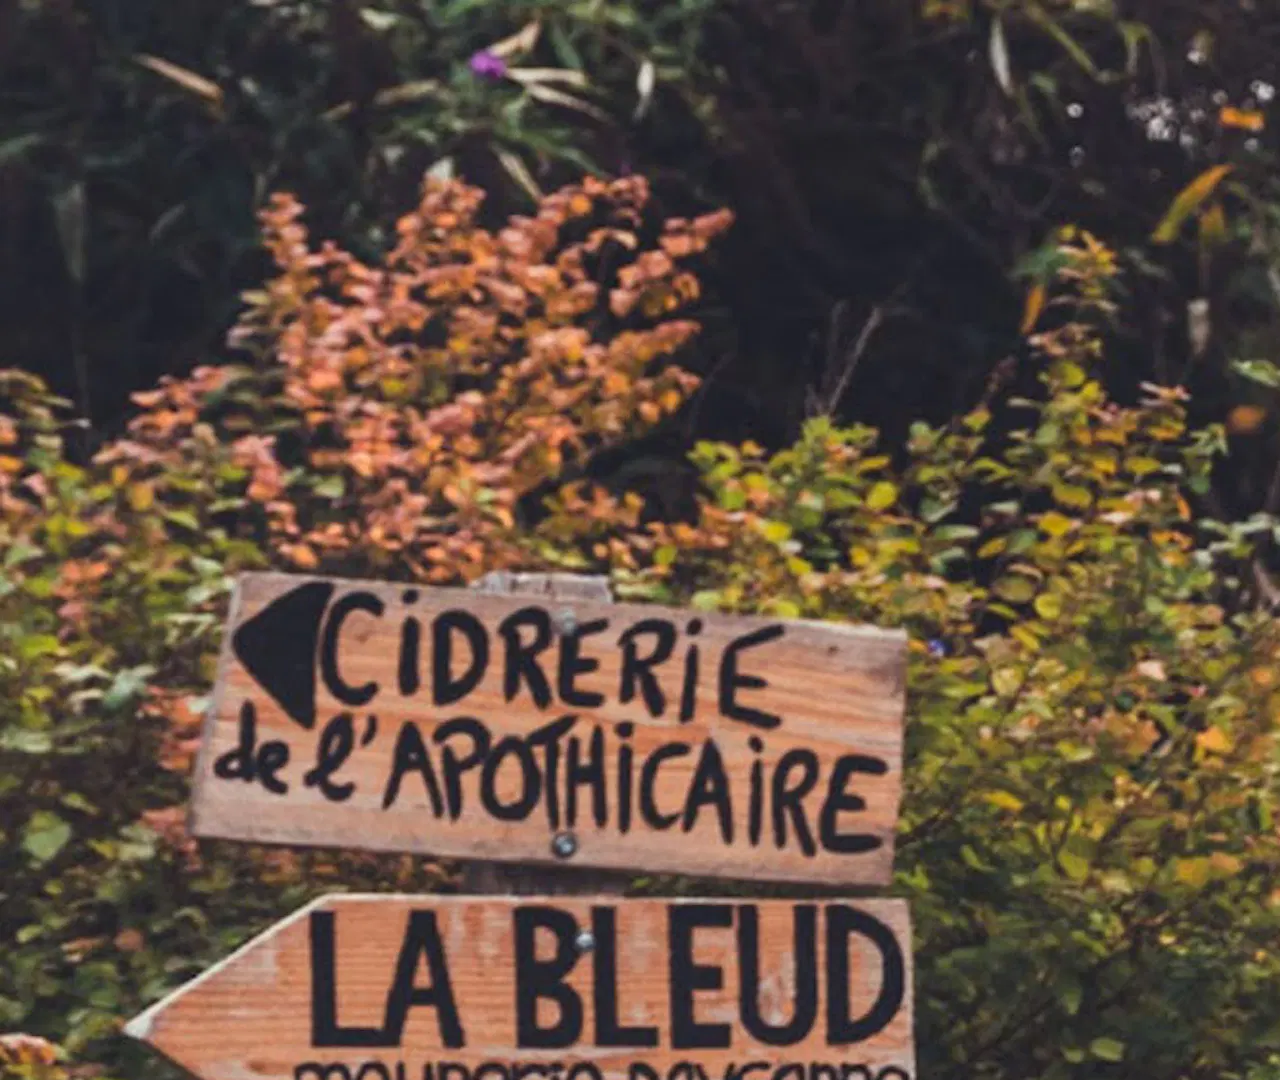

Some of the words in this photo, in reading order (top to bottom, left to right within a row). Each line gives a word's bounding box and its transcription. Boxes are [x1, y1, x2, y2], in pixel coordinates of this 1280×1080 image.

[214, 700, 289, 794] de
[310, 908, 465, 1048] LA
[513, 904, 905, 1049] BLEUD
